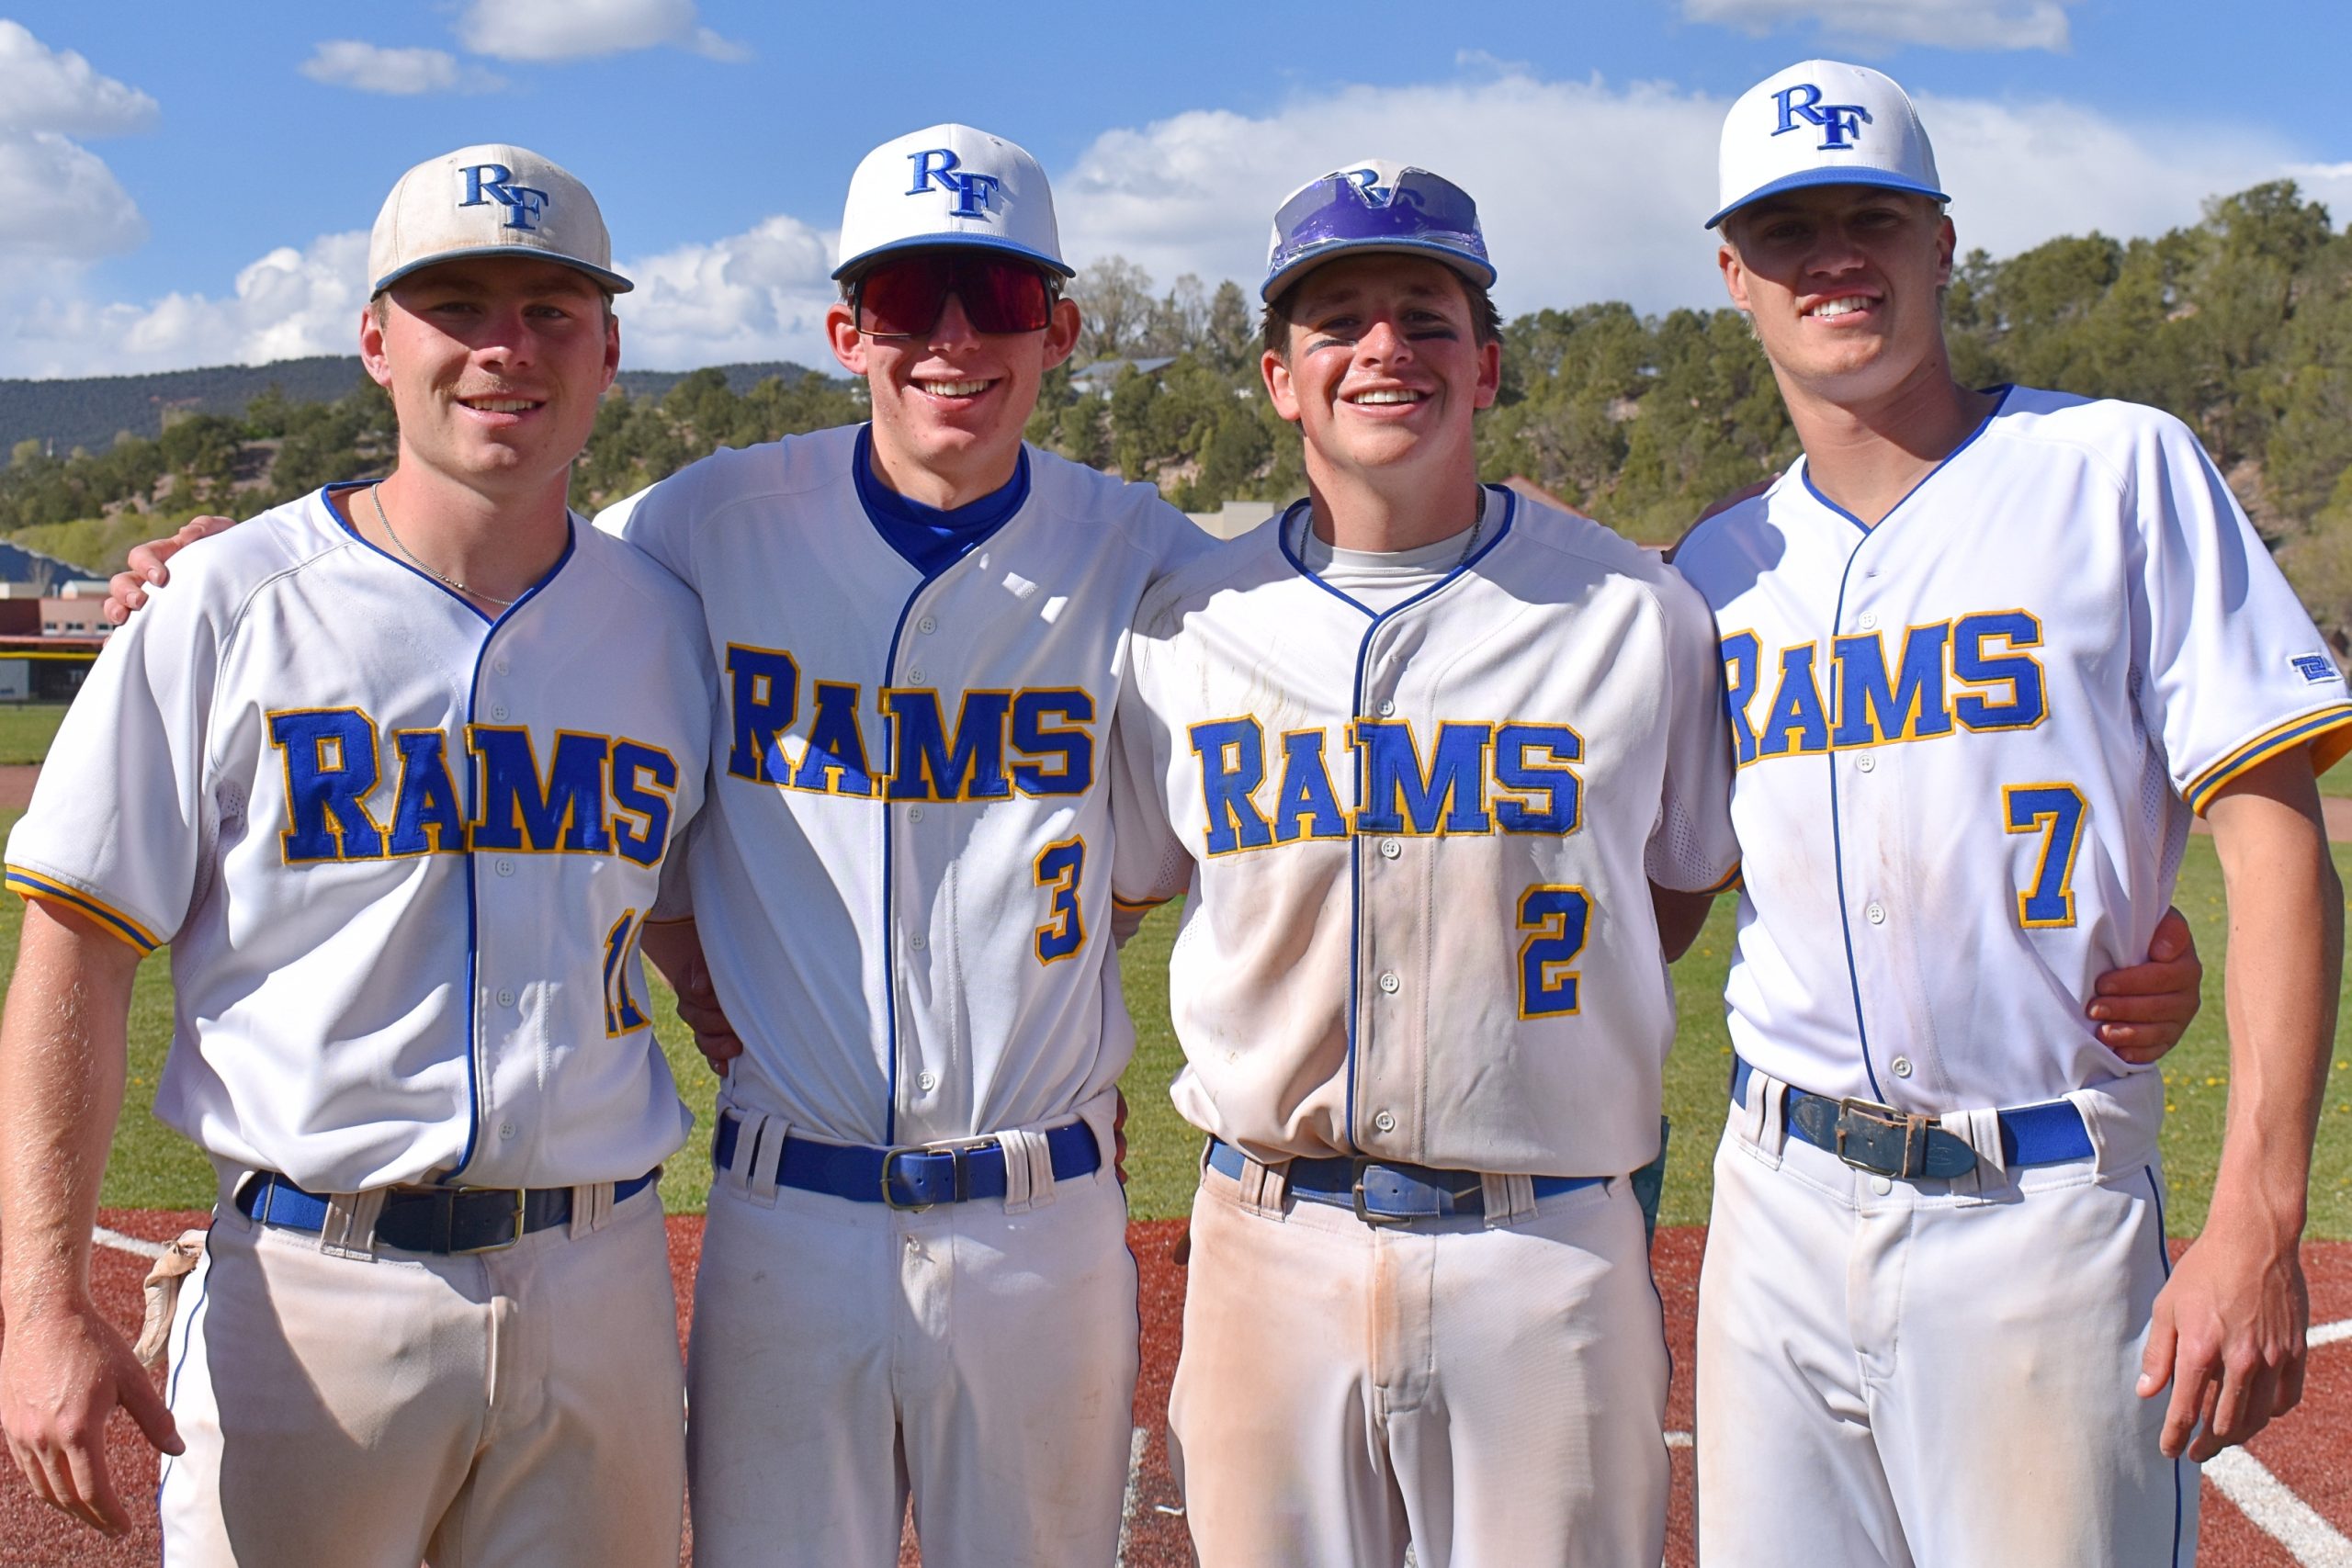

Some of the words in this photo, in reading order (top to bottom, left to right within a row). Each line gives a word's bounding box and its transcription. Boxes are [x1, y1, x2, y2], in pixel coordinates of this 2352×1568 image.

[904, 148, 999, 217] RF
[1770, 83, 1867, 150] RF
[458, 164, 549, 230] RF
[725, 641, 1096, 803] RAMS
[1720, 607, 2050, 772] RAMS
[266, 705, 679, 870] RAMS
[1186, 713, 1585, 860] RAMS
[2001, 782, 2088, 929] 7
[1033, 833, 1089, 966] 3
[1515, 883, 1594, 1021] 2
